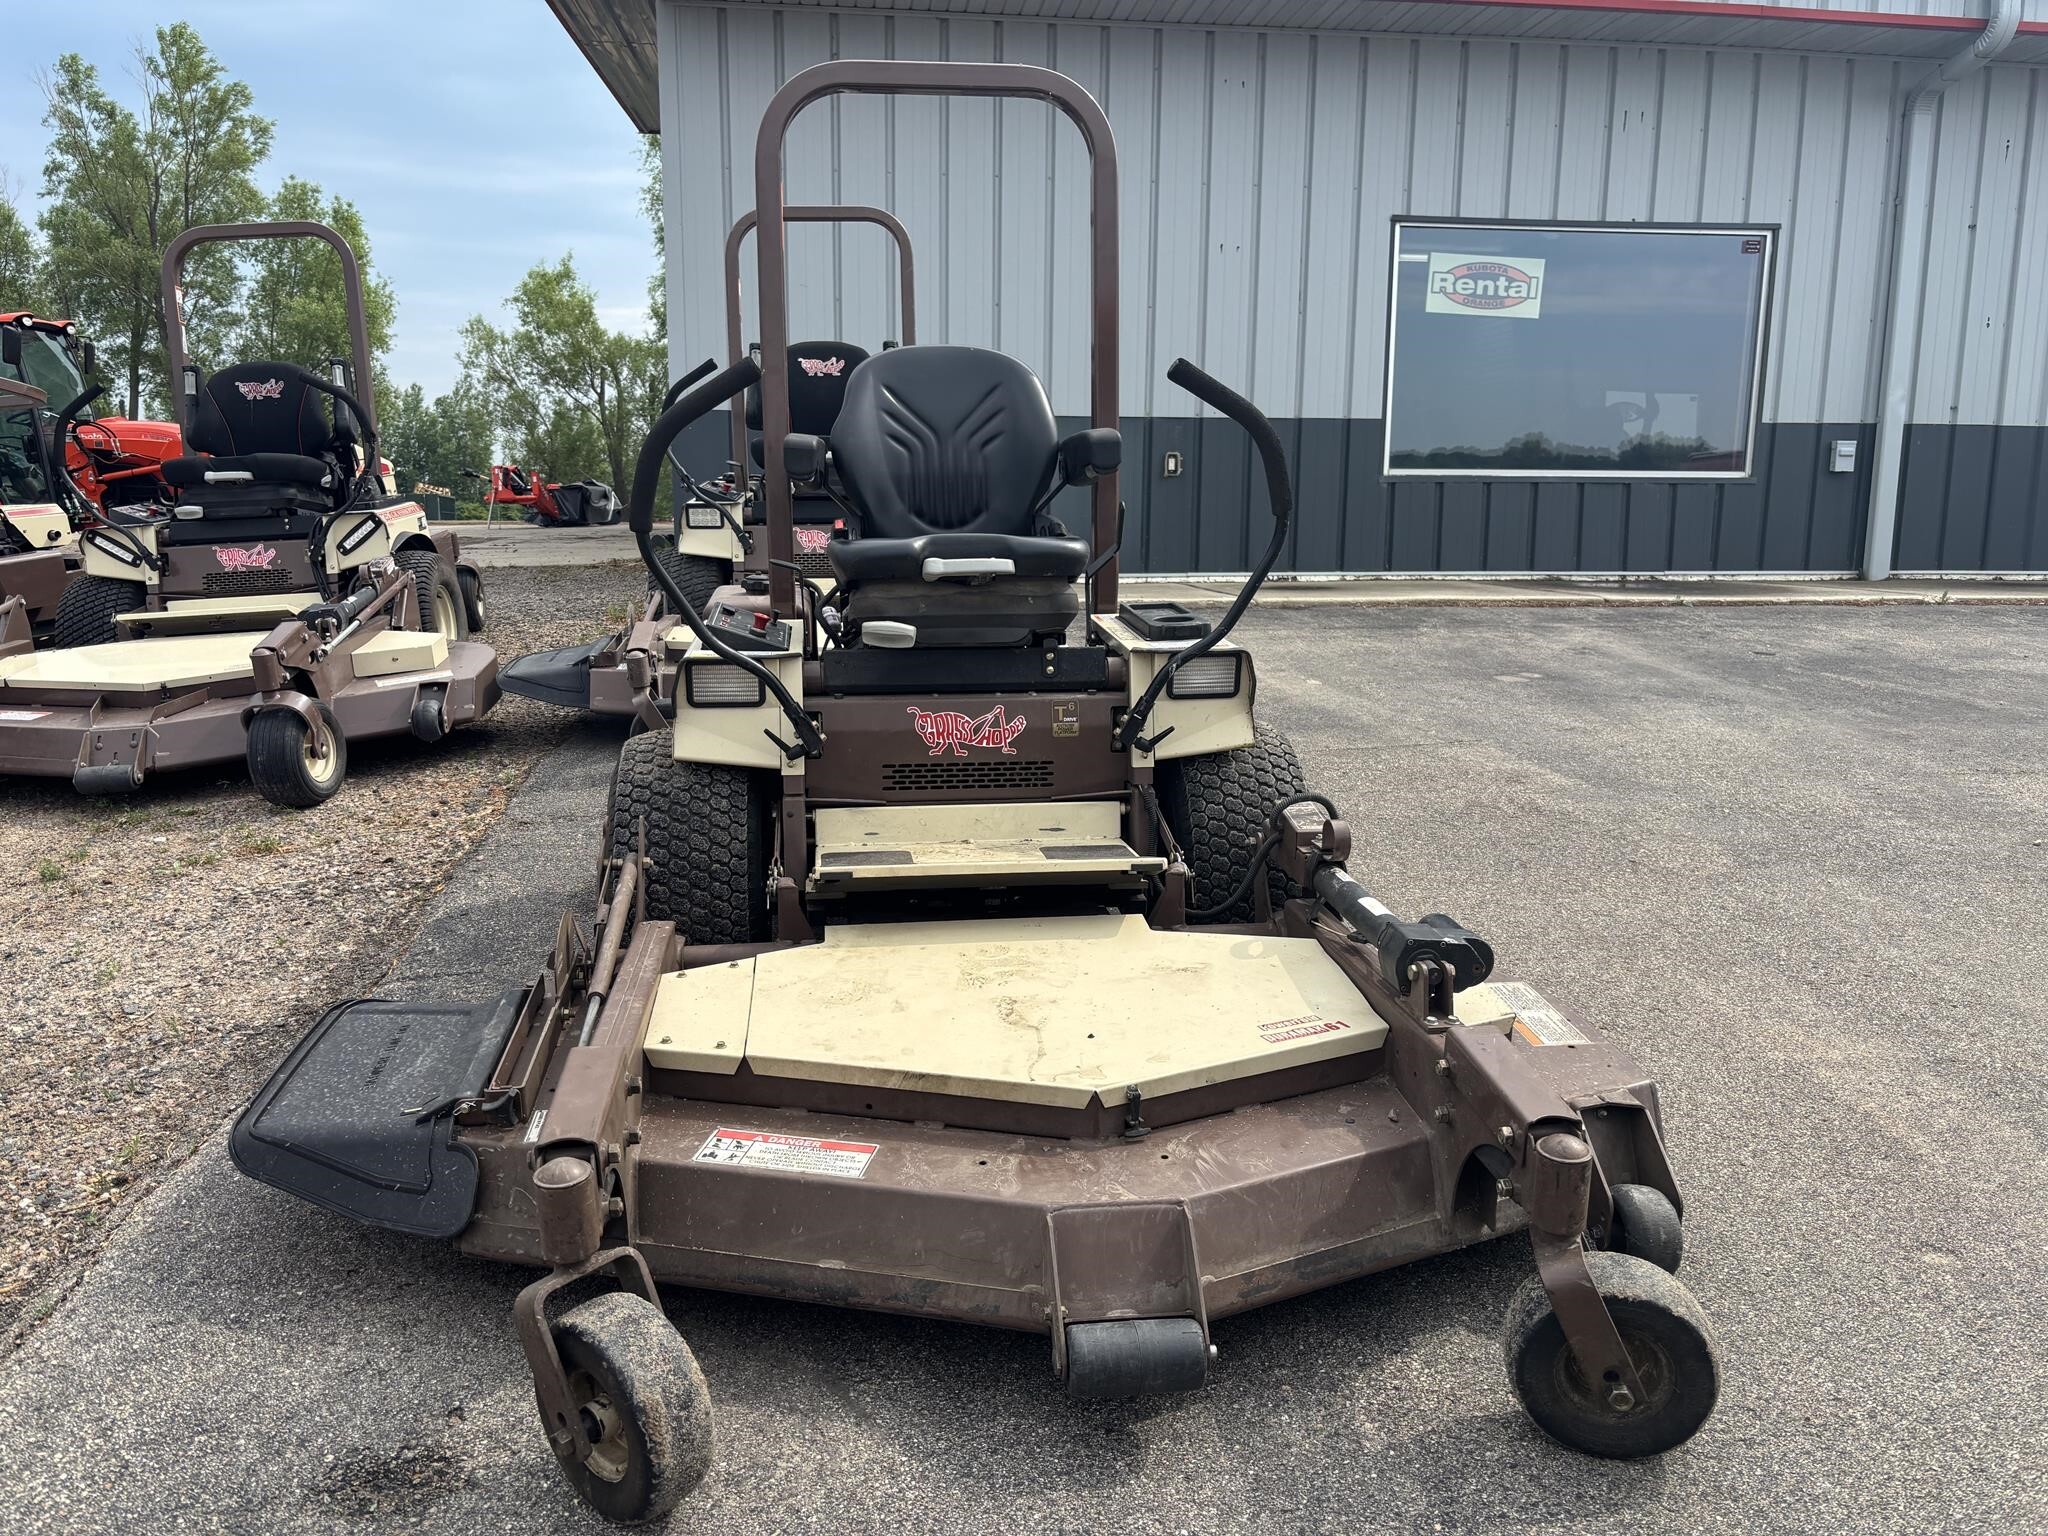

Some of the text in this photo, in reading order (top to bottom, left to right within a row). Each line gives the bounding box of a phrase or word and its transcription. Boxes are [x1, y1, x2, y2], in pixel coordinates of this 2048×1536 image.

[1466, 263, 1509, 274] KUBOTA
[1431, 271, 1539, 299] Rental
[1462, 297, 1506, 308] ORANGE
[910, 707, 1027, 751] GRASSHOPPER
[1323, 1020, 1351, 1031] 61
[768, 1137, 822, 1148] DANGER
